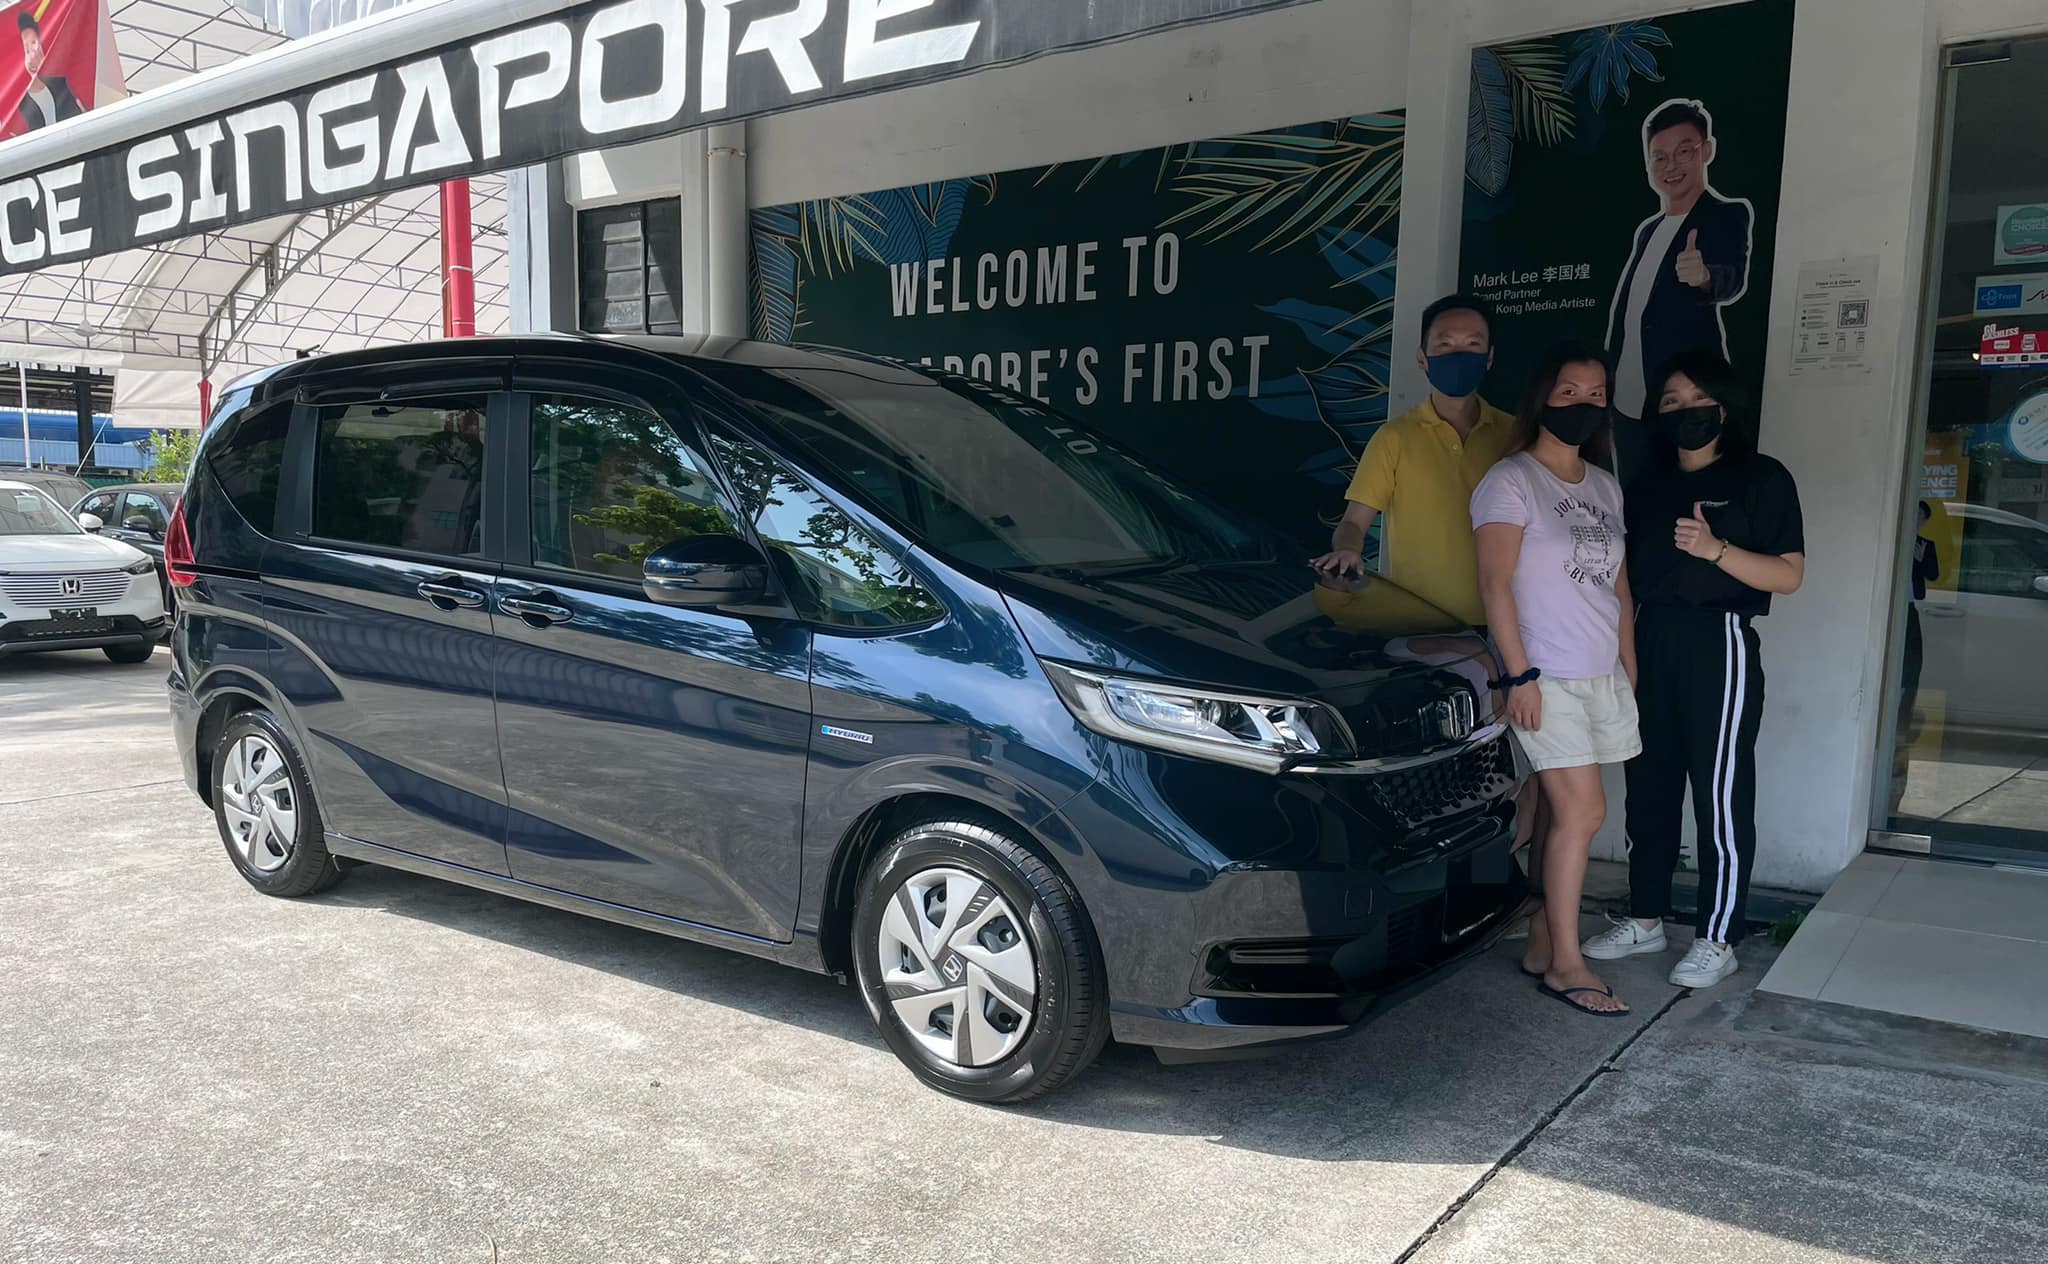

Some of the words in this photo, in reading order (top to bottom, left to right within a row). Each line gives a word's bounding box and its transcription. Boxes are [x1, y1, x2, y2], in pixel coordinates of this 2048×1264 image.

[0, 161, 93, 264] CE
[127, 0, 981, 237] SINGAPORE
[890, 242, 1098, 317] WELCOME
[1122, 232, 1180, 297] TO
[1473, 272, 1508, 288] Mark
[1511, 270, 1538, 284] Lee
[1542, 263, 1591, 282] 李国煌
[1504, 288, 1541, 300] Partner
[1496, 303, 1523, 315] Kong
[1525, 300, 1557, 312] Media
[1560, 298, 1596, 309] Artiste
[1123, 335, 1270, 403] FIRST
